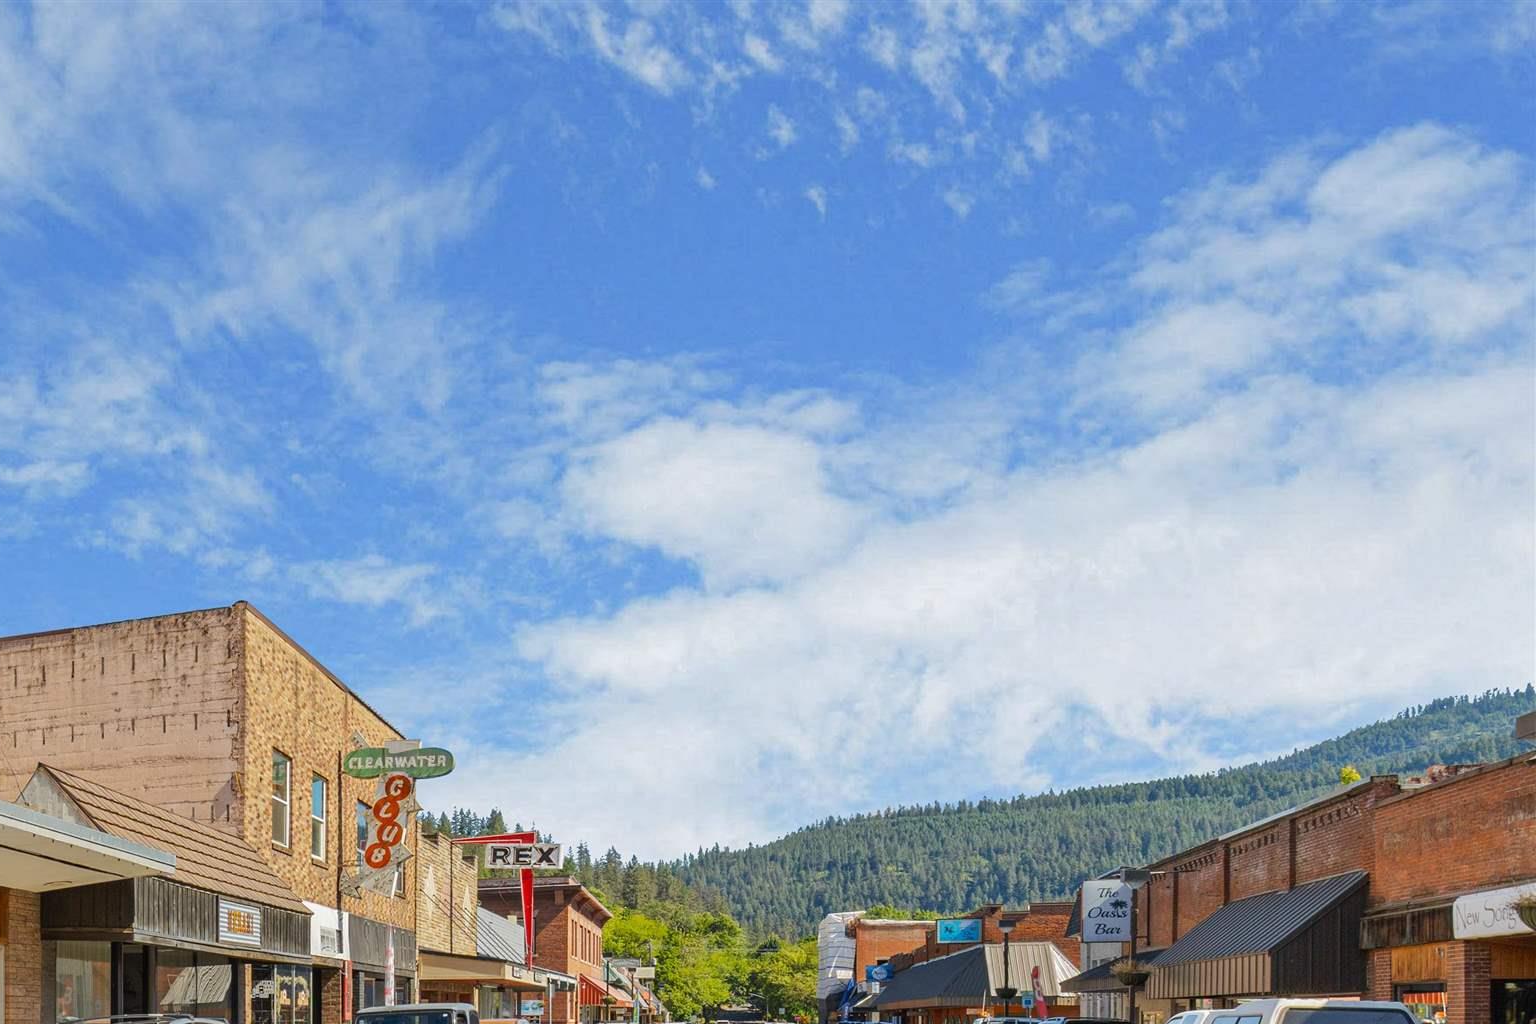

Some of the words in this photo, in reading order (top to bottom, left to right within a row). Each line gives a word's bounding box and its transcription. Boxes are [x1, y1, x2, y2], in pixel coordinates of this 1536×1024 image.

[348, 755, 447, 769] CLEARWATER
[370, 779, 404, 863] CLUB
[490, 845, 559, 866] REX
[1097, 887, 1119, 898] The
[1087, 906, 1128, 919] Oasis
[1456, 903, 1480, 931] New
[1095, 923, 1121, 935] Bar
